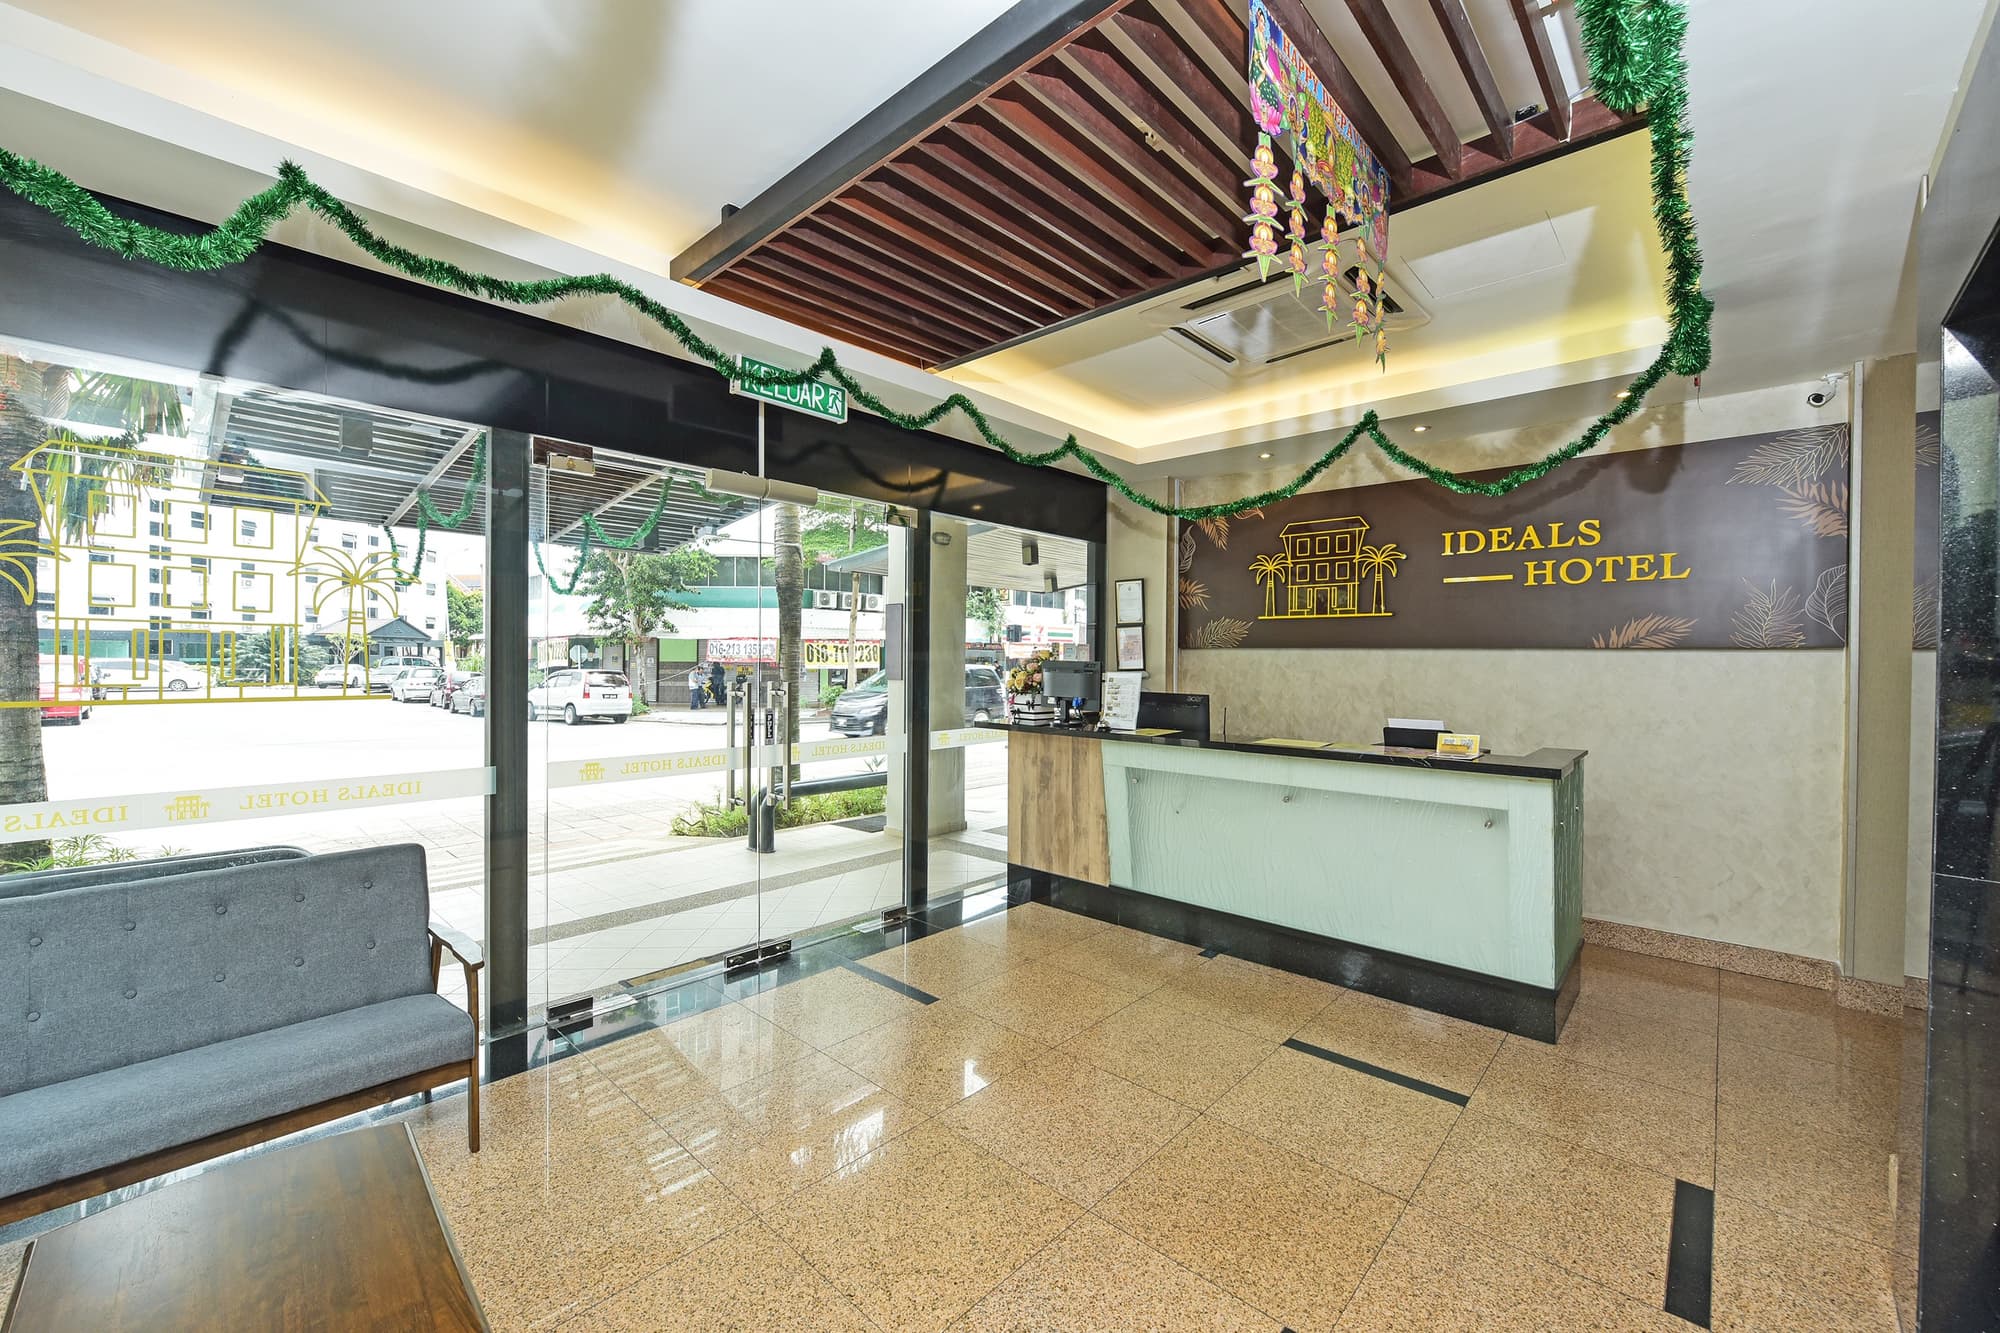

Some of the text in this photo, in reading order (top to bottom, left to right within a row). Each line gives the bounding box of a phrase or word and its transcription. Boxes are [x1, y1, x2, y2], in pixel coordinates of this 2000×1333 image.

[1282, 34, 1320, 93] HAPPY
[744, 360, 826, 412] KELUAR
[1440, 519, 1602, 556] IDEALS
[1522, 551, 1692, 587] HOTEL
